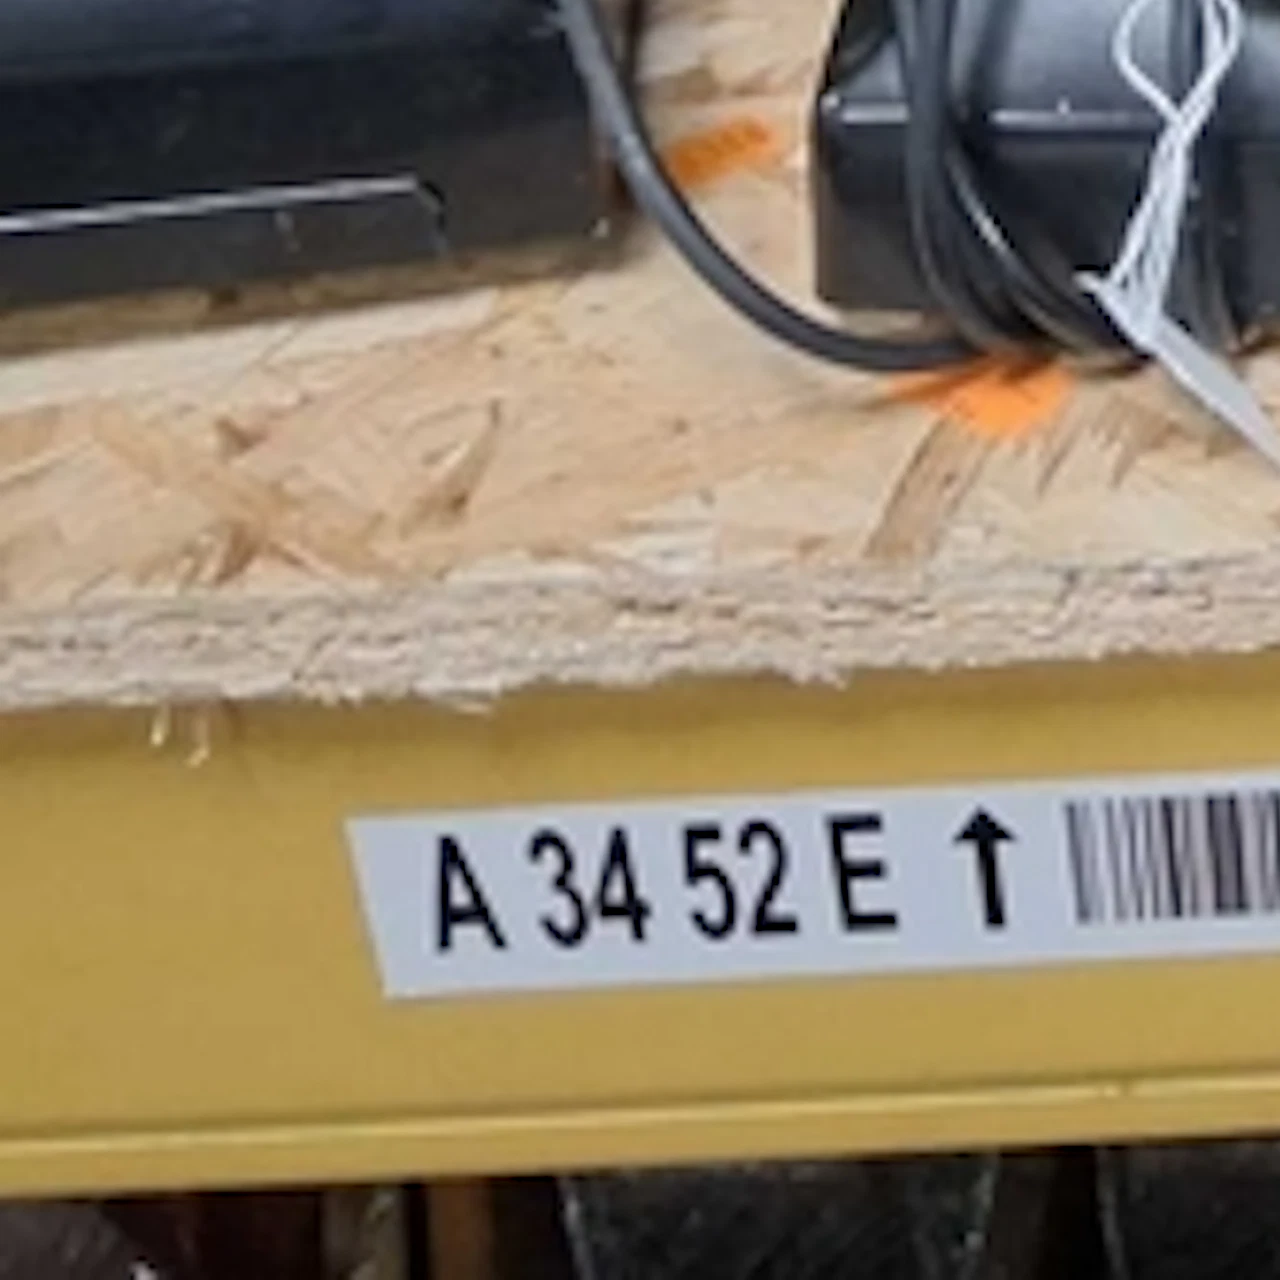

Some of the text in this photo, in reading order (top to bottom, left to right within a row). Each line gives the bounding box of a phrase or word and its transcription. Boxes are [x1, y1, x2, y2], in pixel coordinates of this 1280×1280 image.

[436, 834, 508, 952] A
[528, 827, 651, 948] 34
[682, 819, 799, 941] 52
[825, 812, 898, 932] E
